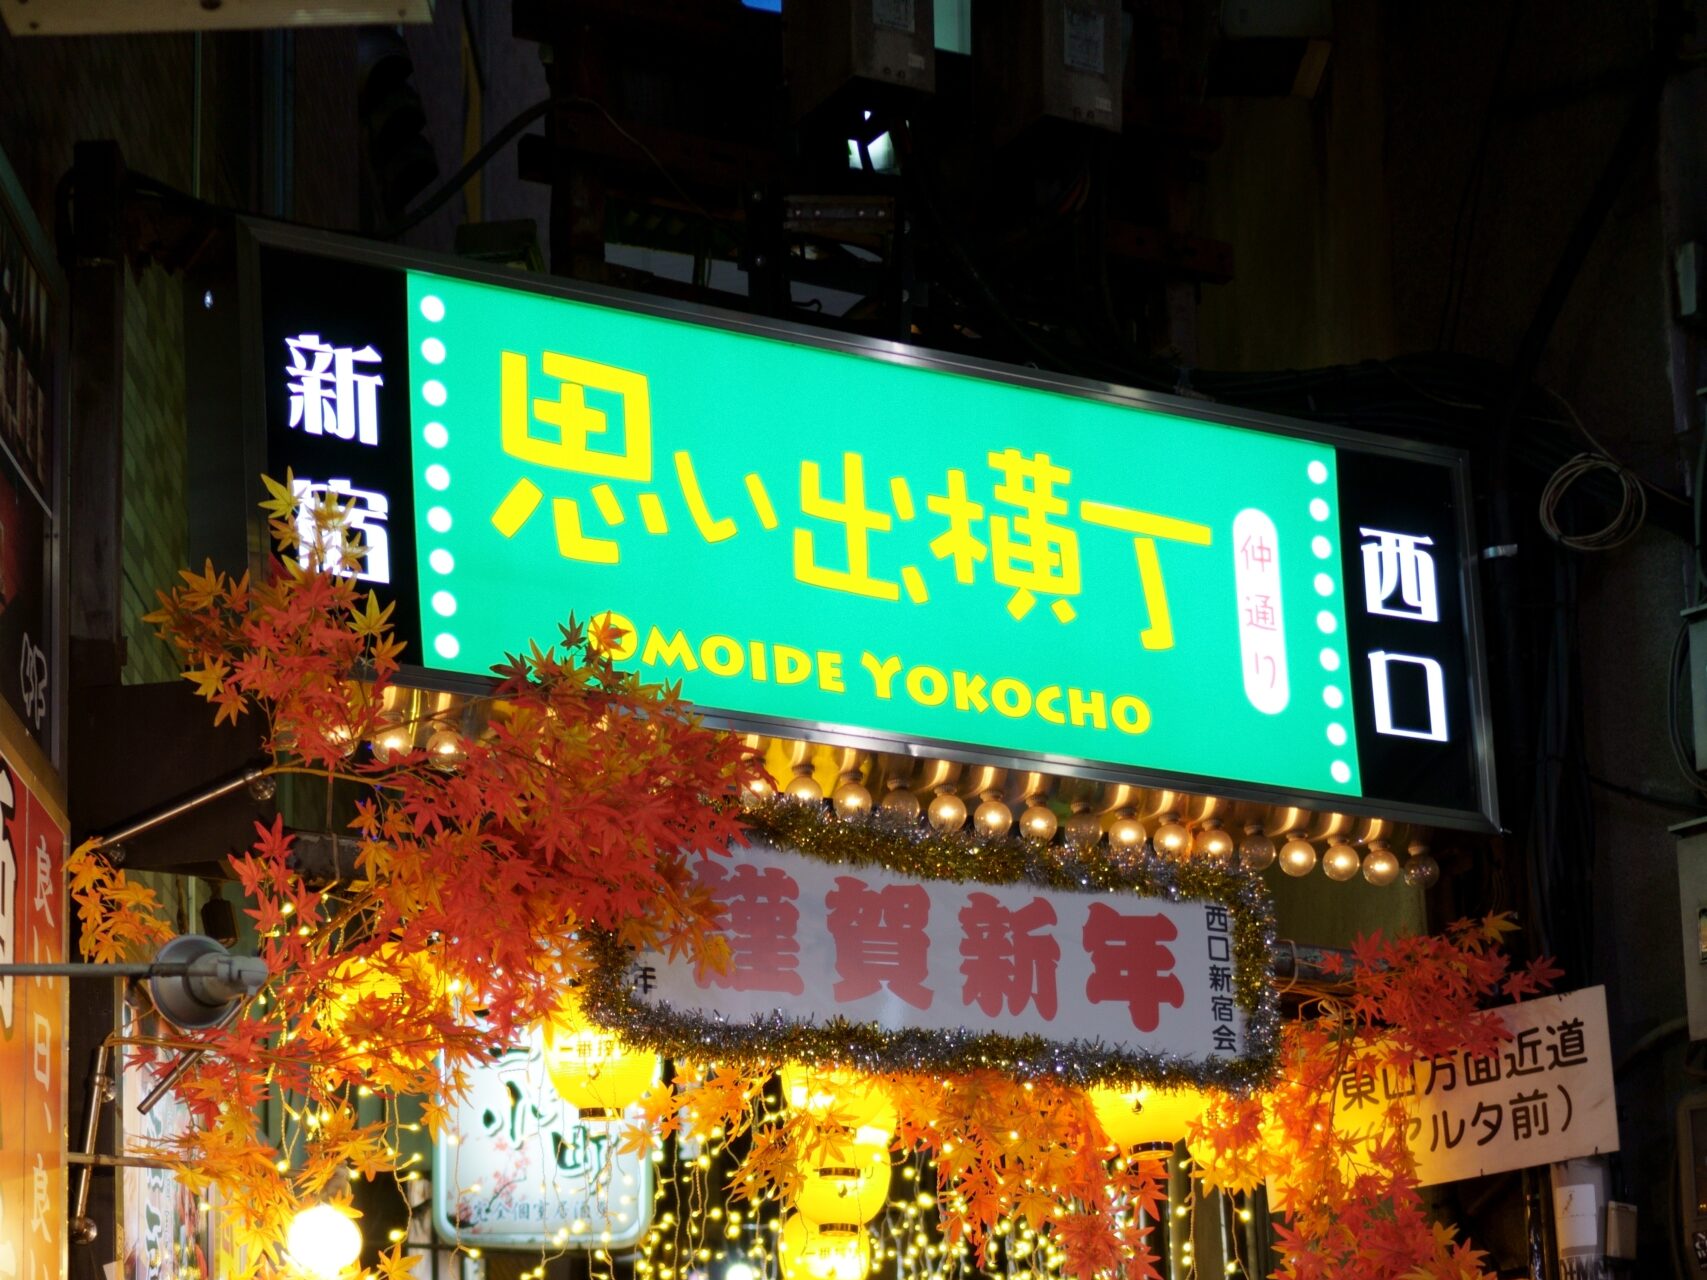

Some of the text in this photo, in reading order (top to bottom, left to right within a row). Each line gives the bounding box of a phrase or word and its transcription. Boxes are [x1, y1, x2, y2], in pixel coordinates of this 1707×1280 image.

[492, 349, 1212, 652] 思い出横丁
[587, 611, 1152, 735] OMOIDE YOKOCHO
[1359, 526, 1449, 743] 西口
[1204, 903, 1239, 1054] 西口新宿会
